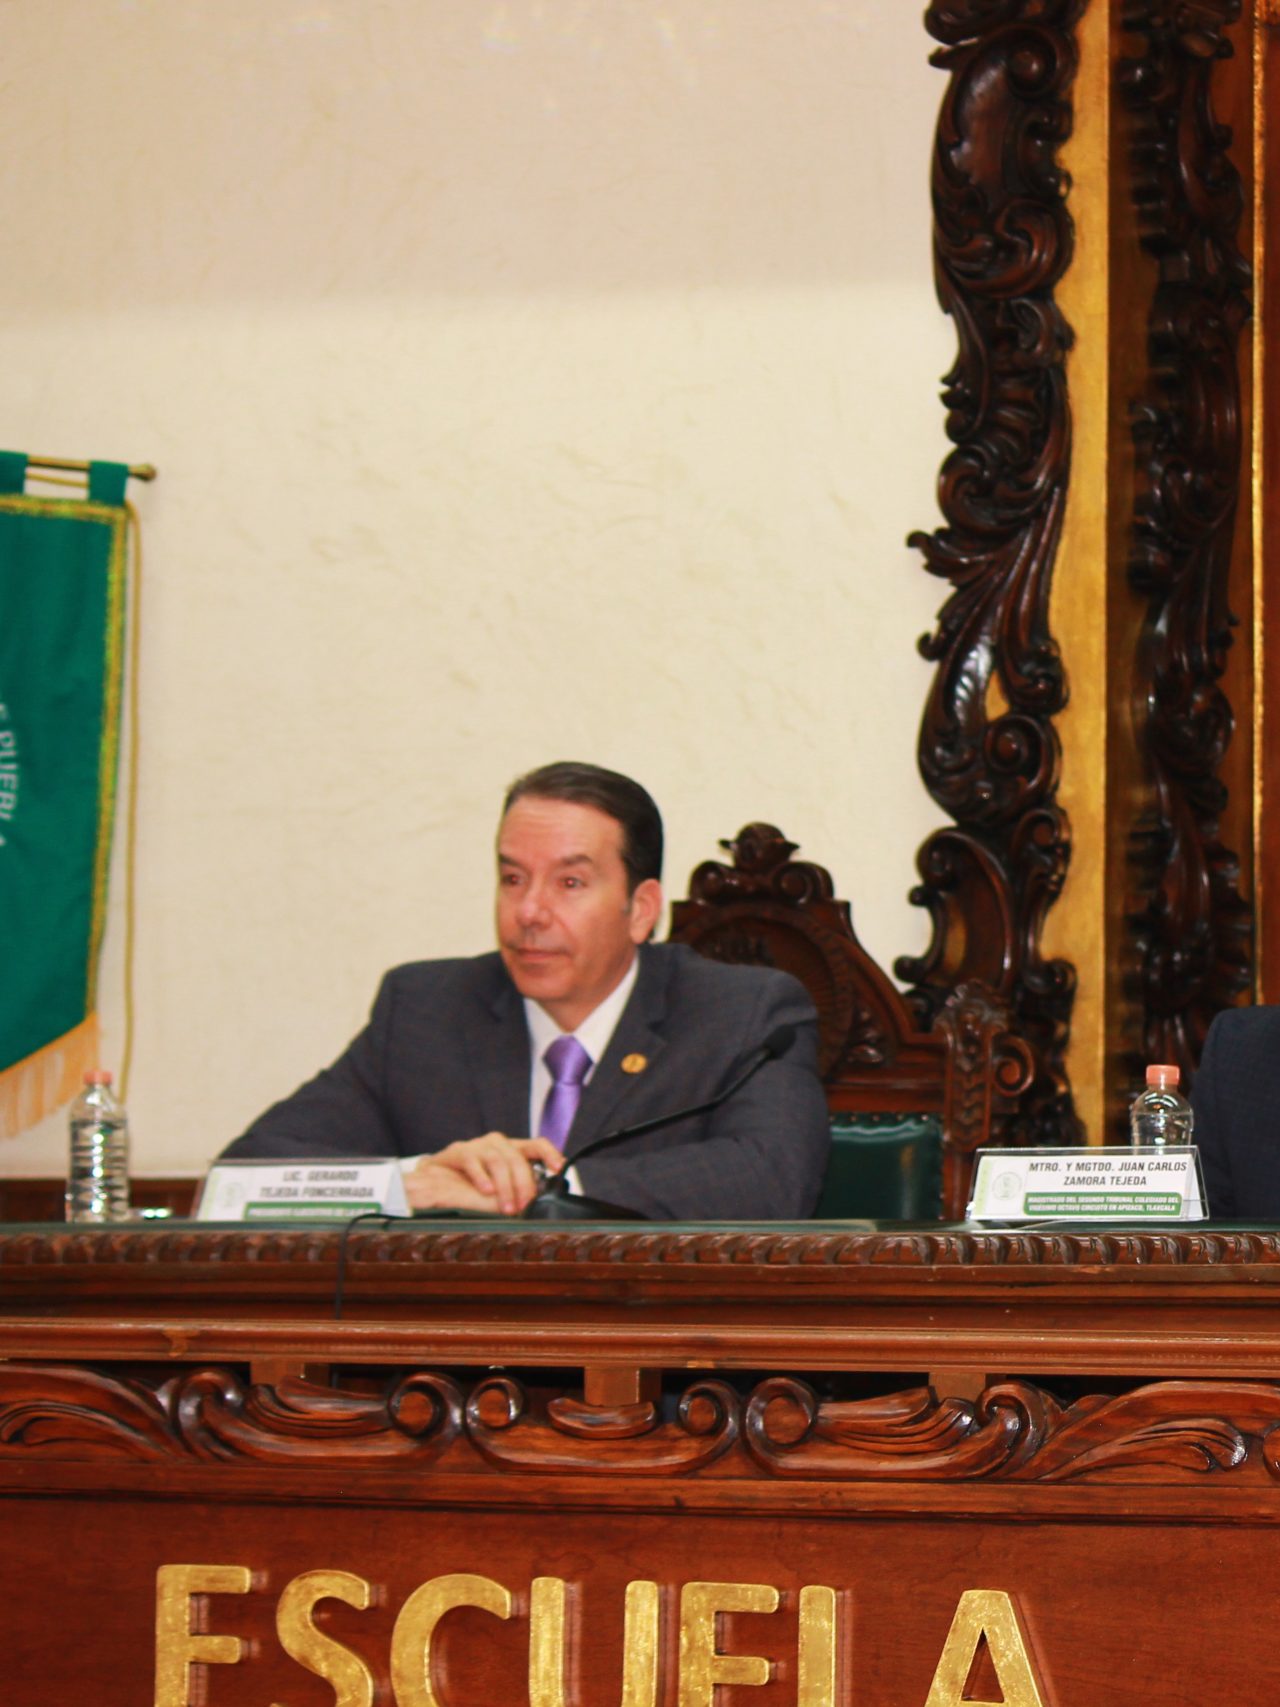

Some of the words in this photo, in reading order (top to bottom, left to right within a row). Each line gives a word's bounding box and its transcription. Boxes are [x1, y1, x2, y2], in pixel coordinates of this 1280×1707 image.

[0, 731, 17, 847] PUEBL
[1028, 1162, 1061, 1172] MTRO.
[1065, 1162, 1073, 1172] Y
[1075, 1162, 1115, 1172] MGTDO.
[1117, 1162, 1145, 1172] JUAN
[1147, 1161, 1187, 1171] CARLOS
[307, 1170, 360, 1182] GERARDO
[1063, 1176, 1106, 1187] ZAMORA
[1109, 1176, 1147, 1186] TEJEDA
[259, 1187, 299, 1198] TEJEDA
[154, 1562, 1045, 1707] ESCUELA
